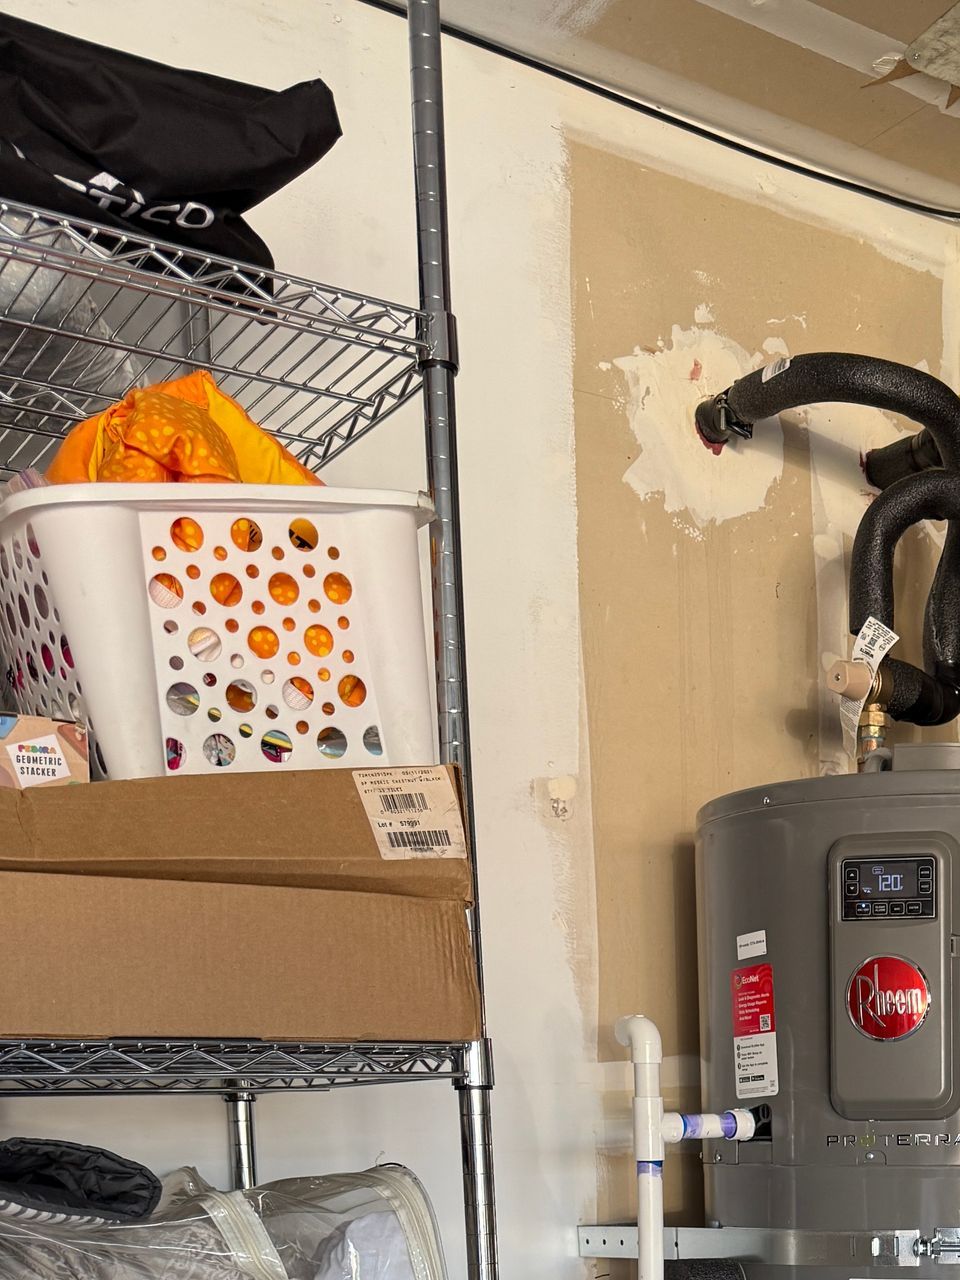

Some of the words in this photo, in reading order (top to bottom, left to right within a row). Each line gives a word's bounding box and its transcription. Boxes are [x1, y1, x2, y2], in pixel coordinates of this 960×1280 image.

[16, 754, 62, 766] GEOMETRIC
[20, 766, 57, 777] STACKER
[742, 975, 759, 985] EcoNet
[856, 963, 923, 1028] Rheem
